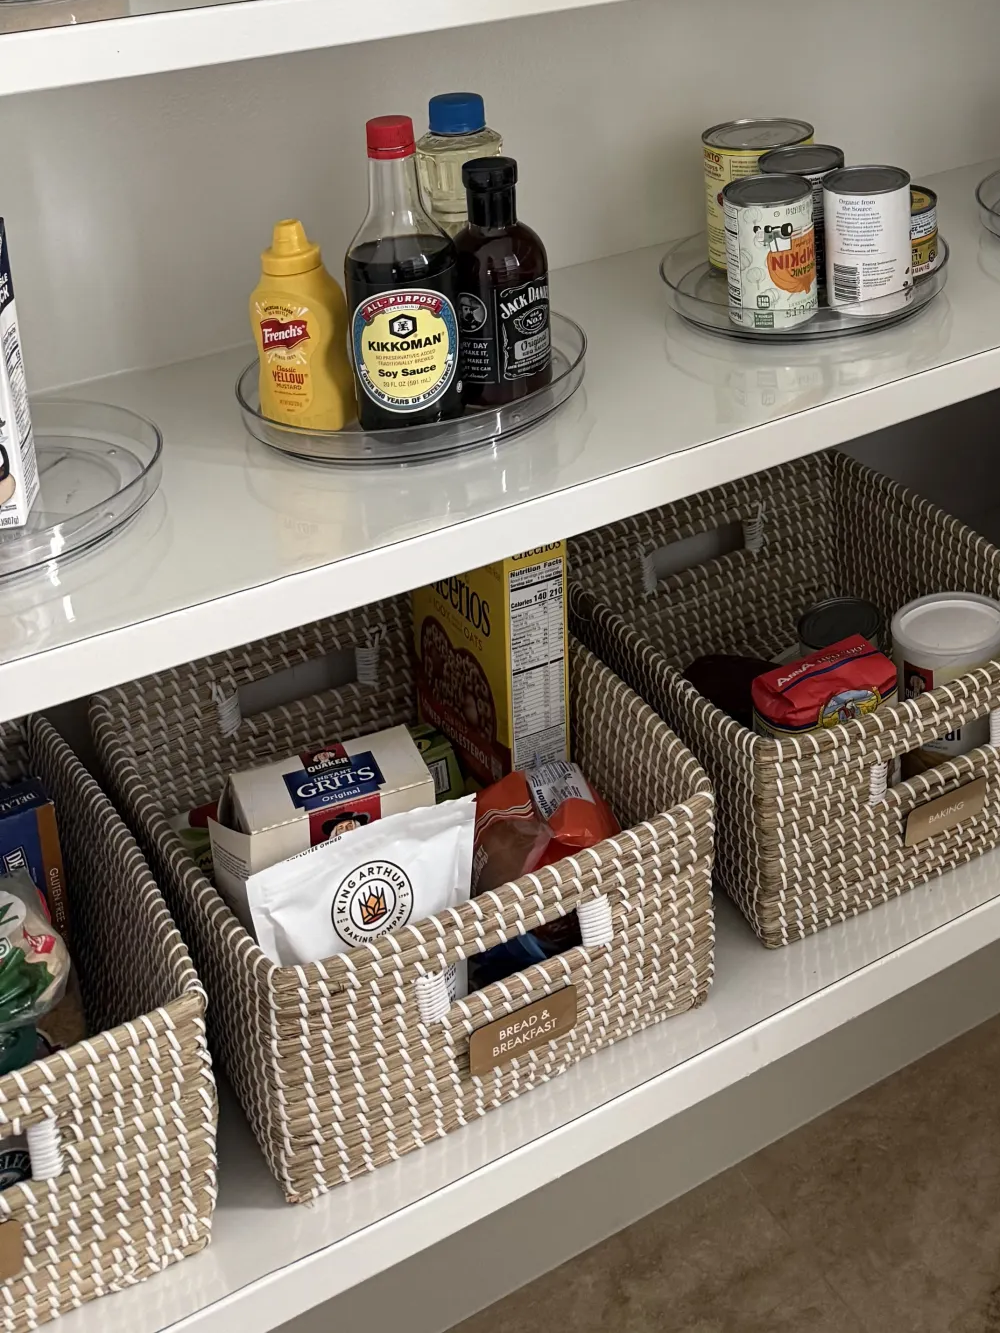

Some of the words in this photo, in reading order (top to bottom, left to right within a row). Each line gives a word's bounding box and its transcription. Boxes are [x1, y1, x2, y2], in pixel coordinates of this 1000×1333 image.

[838, 198, 860, 207] Organic
[861, 198, 876, 206] from
[366, 294, 438, 313] ALL-PURPOSE
[385, 304, 419, 313] SEASONING
[500, 293, 530, 319] JACK
[262, 324, 304, 344] French's
[367, 332, 442, 352] KIKKOMAN
[520, 332, 547, 352] Original
[272, 371, 305, 385] YELLOW
[276, 364, 297, 373] Classic
[378, 368, 399, 379] Soy
[401, 364, 437, 377] Sauce
[276, 382, 302, 391] MUSTARD
[362, 372, 375, 390] OVER
[386, 395, 410, 405] YEARS
[411, 396, 422, 405] OF
[422, 363, 453, 400] EXCELLENCE
[510, 565, 541, 578] Nutrition
[543, 558, 562, 569] Facts
[511, 597, 533, 609] Calories
[534, 591, 548, 602] 140
[549, 586, 563, 597] 210
[463, 627, 484, 652] OATS
[775, 661, 816, 687] ANNA
[442, 722, 492, 765] CHOLESTEROL
[307, 757, 349, 773] QUAKER
[313, 767, 352, 783] INSTANT
[296, 766, 375, 798] GRITS
[321, 786, 361, 802] Original
[928, 801, 965, 824] BAKING
[319, 835, 343, 849] OWNED
[49, 867, 61, 900] GLUTEN
[55, 899, 67, 924] FREE
[337, 878, 357, 915] KING
[358, 865, 406, 891] ARTHUR
[343, 925, 374, 943] BAKING
[498, 1015, 538, 1041] BREAD
[541, 1008, 551, 1020] &
[492, 1017, 558, 1058] BREAKFAST
